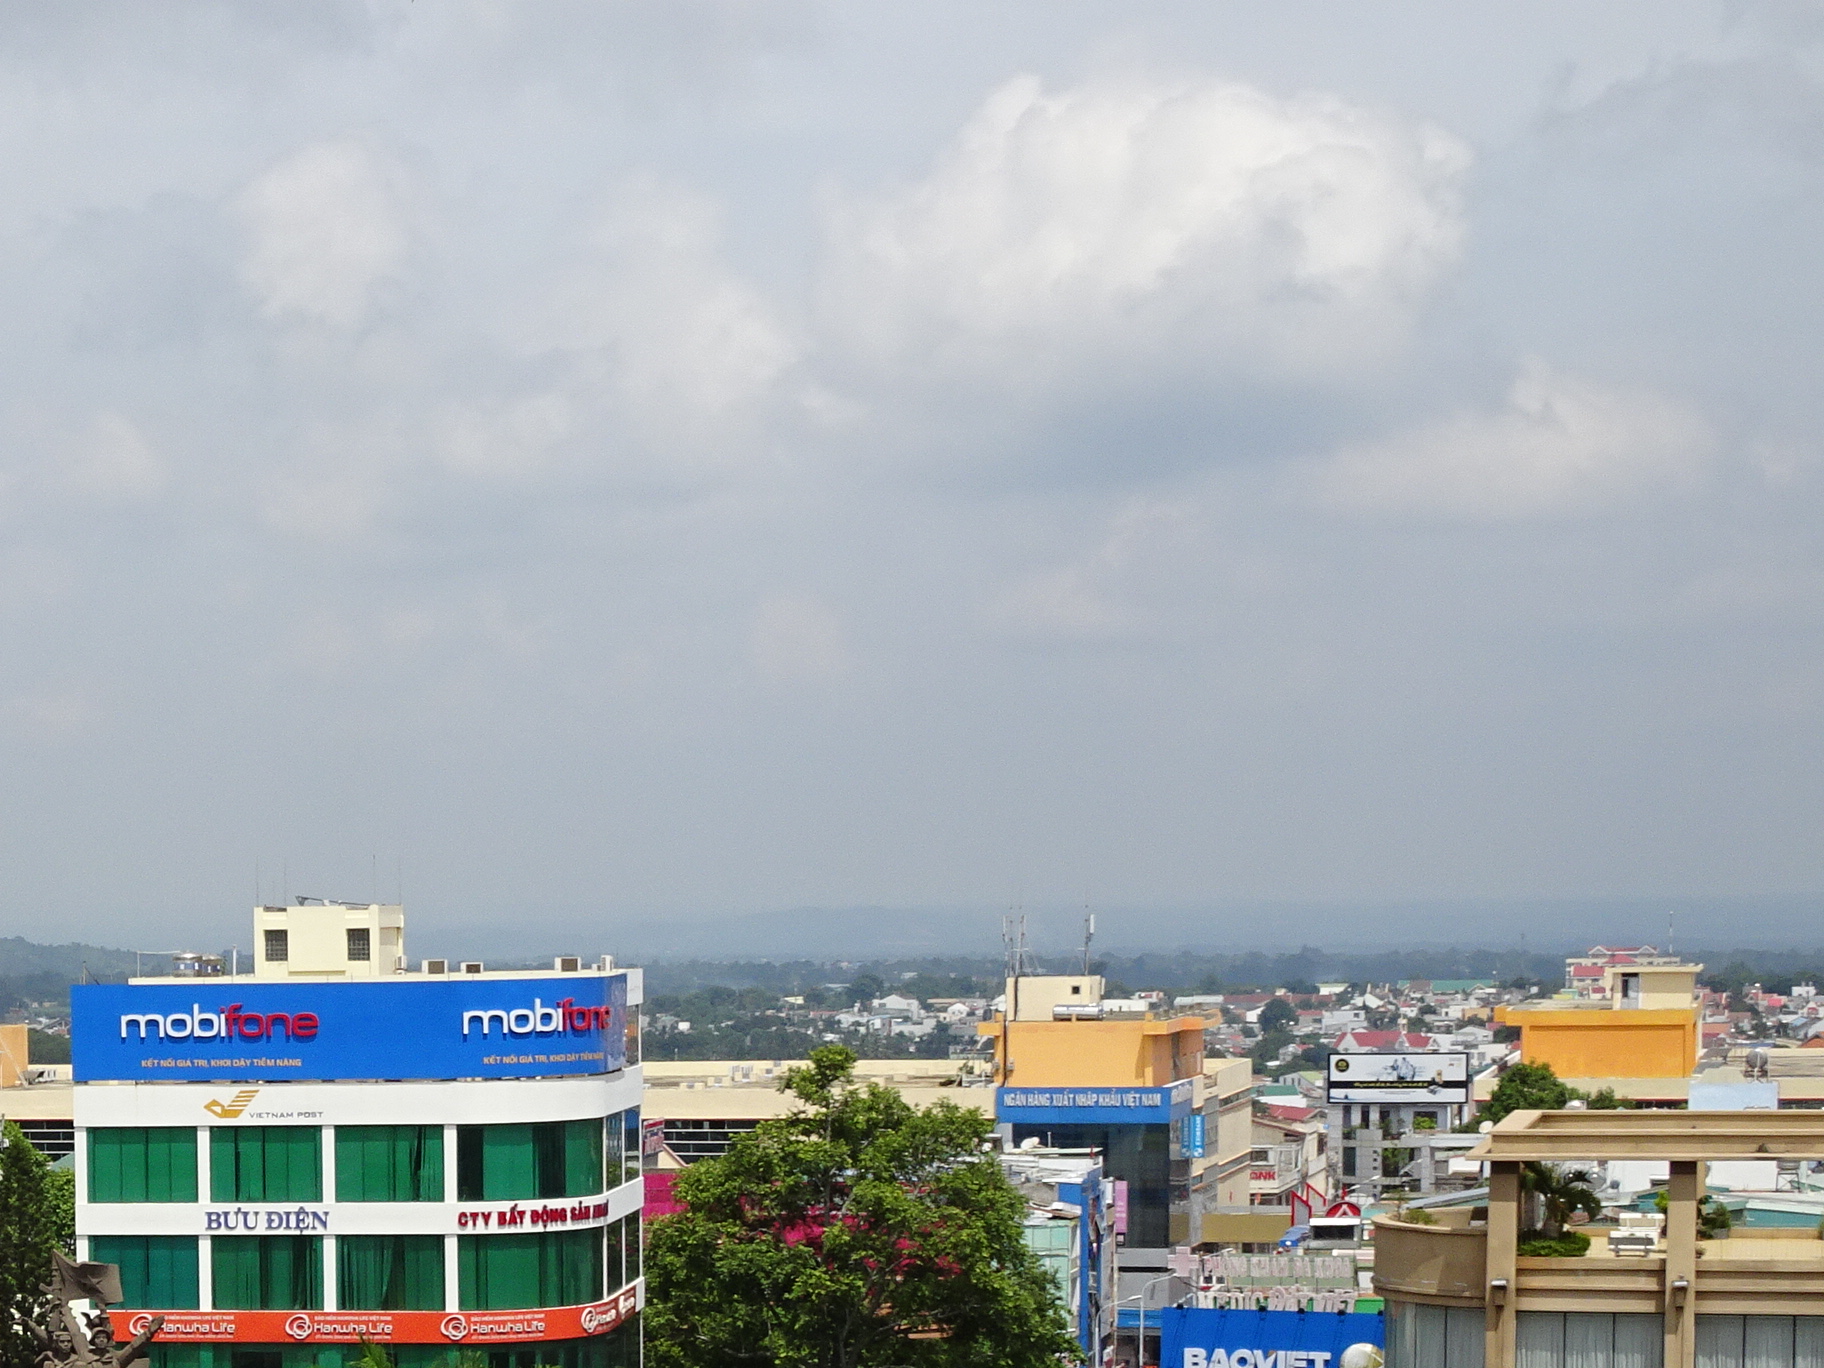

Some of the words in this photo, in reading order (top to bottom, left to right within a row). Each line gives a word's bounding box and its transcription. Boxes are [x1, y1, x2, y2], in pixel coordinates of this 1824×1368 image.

[120, 1003, 320, 1038] mobifone
[462, 998, 612, 1035] mobifone
[1003, 1090, 1027, 1107] NGÂN
[1027, 1090, 1051, 1107] HÀNG
[1052, 1088, 1074, 1107] XUẤT
[1098, 1088, 1121, 1107] KHẨU
[1122, 1090, 1140, 1109] VIỆT
[1141, 1093, 1162, 1107] NAM
[205, 1206, 259, 1231] BƯU
[264, 1206, 330, 1235] ĐIỆN
[457, 1210, 492, 1228] CTY
[497, 1203, 526, 1226] BẤT
[530, 1204, 568, 1231] ĐỘNG
[570, 1200, 591, 1221] SẢN
[211, 1322, 236, 1333] Life
[314, 1322, 367, 1334] Hanwha
[369, 1322, 393, 1334] Life
[470, 1322, 523, 1334] Hanwha
[524, 1320, 546, 1332] Life
